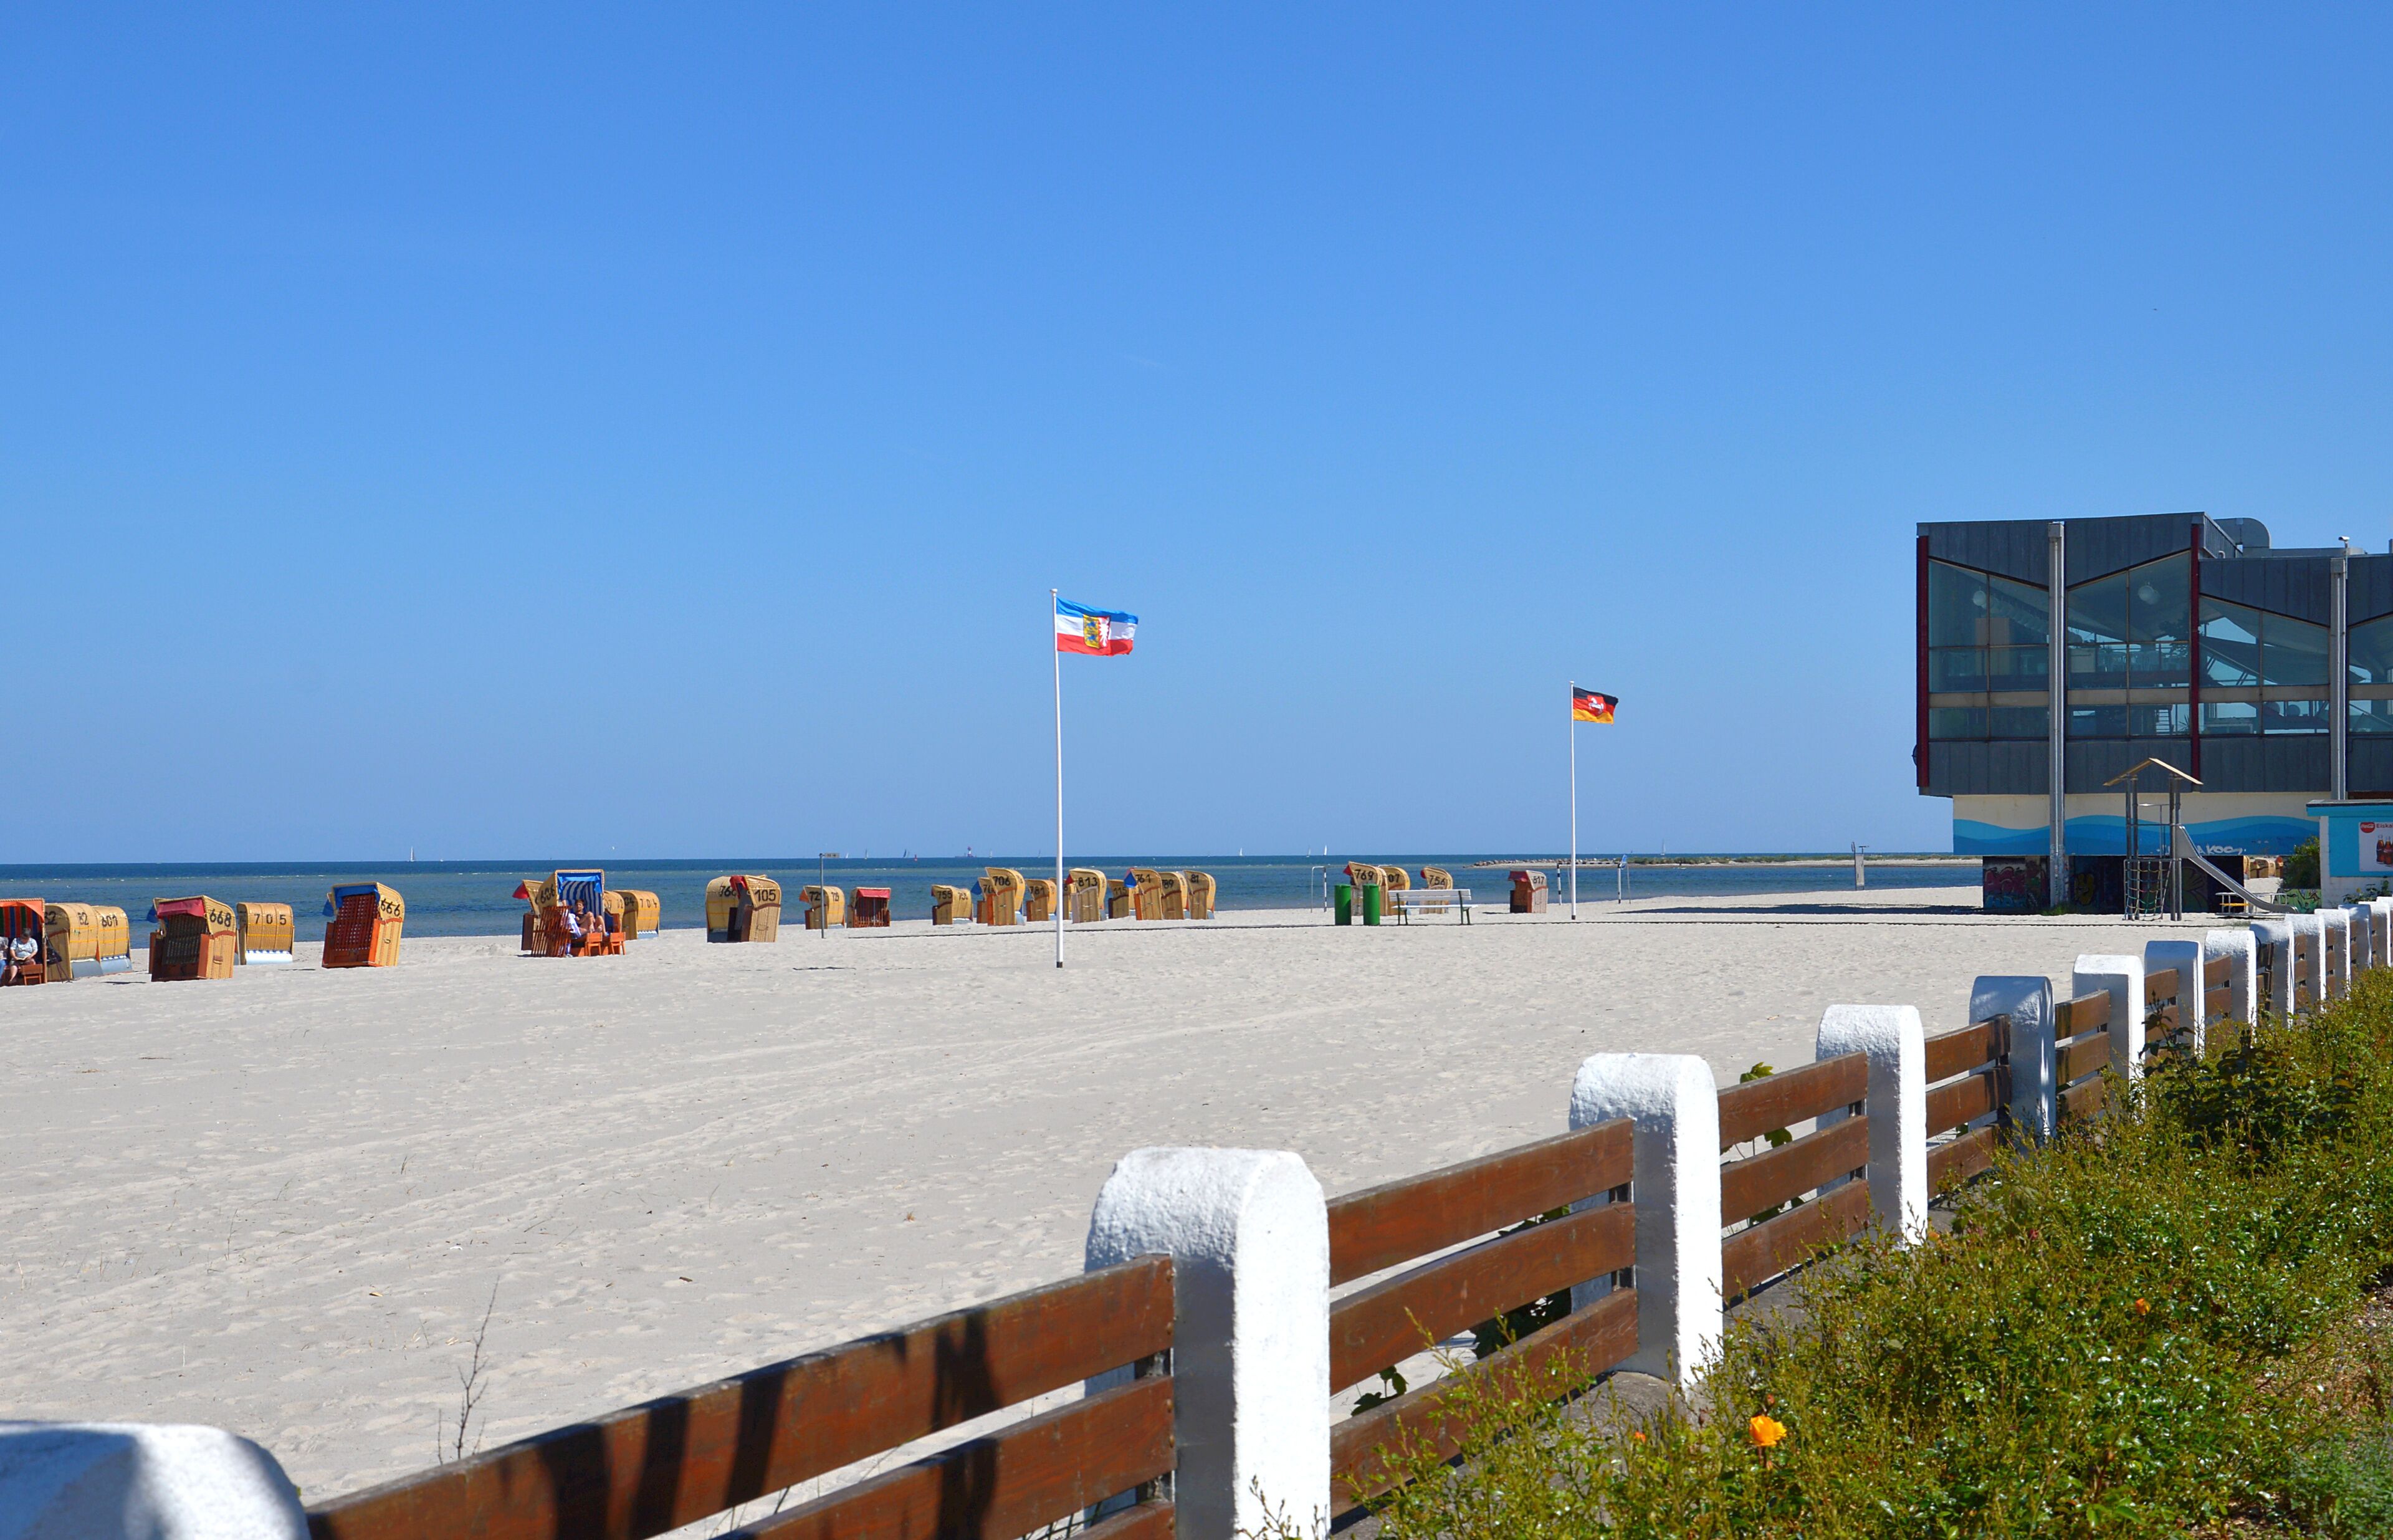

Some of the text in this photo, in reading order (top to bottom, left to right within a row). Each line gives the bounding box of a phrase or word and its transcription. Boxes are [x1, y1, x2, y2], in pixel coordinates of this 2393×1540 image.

[993, 875, 1011, 886] 706
[1190, 874, 1200, 884] 81
[1355, 869, 1373, 881] 769
[1388, 874, 1400, 883] 07
[1430, 875, 1446, 886] 756
[1078, 877, 1098, 887] 813
[755, 889, 776, 902] 105
[381, 898, 401, 917] 666
[624, 897, 635, 907] 04
[639, 898, 657, 909] 704
[209, 909, 232, 927] 668
[254, 913, 287, 925] 705
